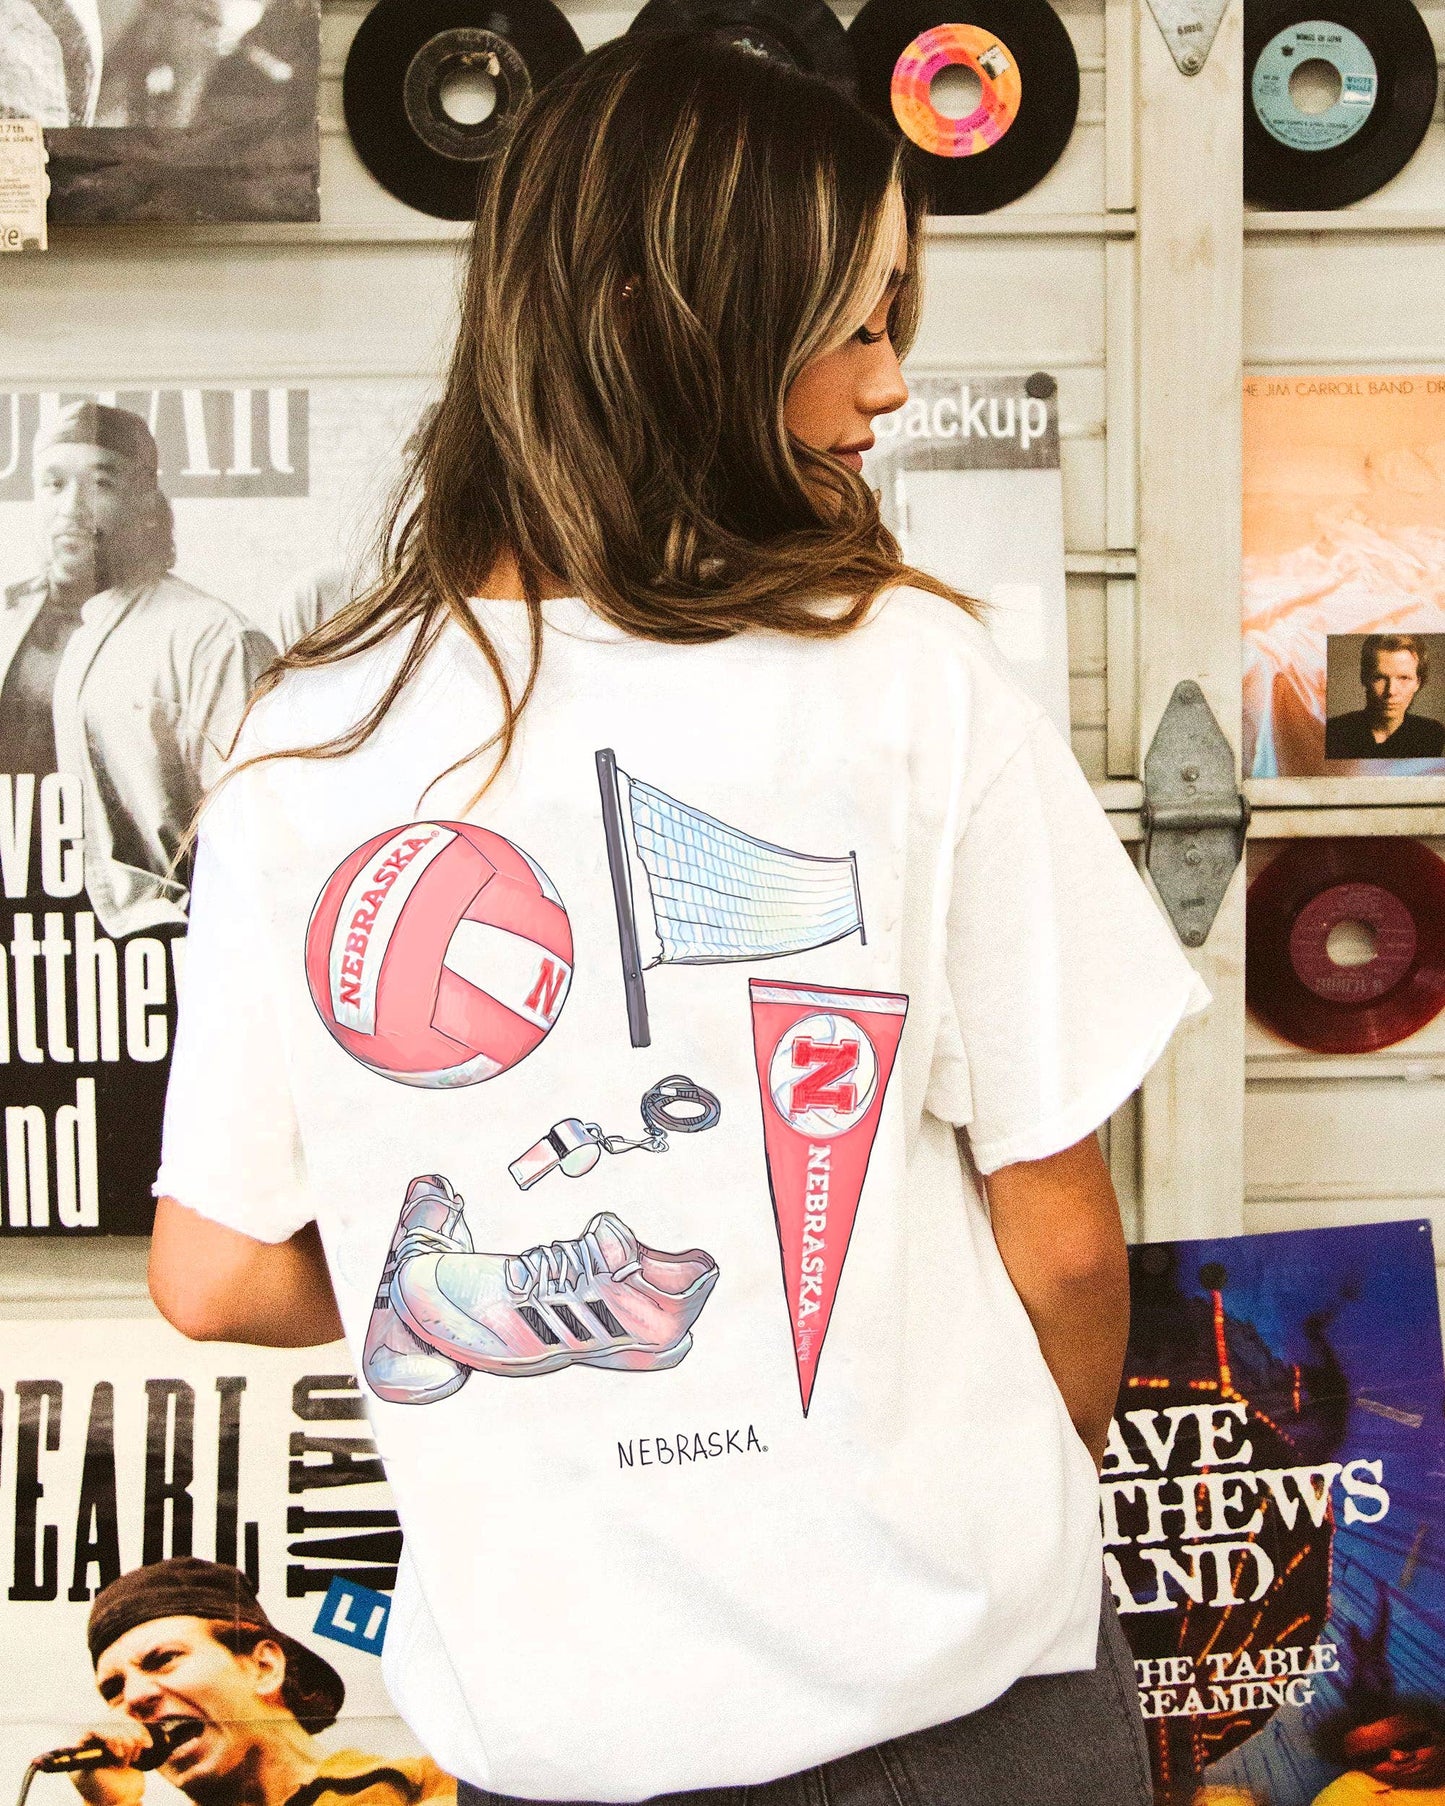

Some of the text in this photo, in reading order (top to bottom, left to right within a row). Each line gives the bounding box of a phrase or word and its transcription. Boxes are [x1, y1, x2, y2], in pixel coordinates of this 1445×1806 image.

[1266, 383, 1290, 396] JIM
[1296, 382, 1363, 396] CARROLL
[1369, 381, 1414, 395] BAND
[0, 912, 186, 1064] tthe
[790, 1036, 860, 1114] N
[0, 1077, 99, 1228] nd
[0, 1376, 260, 1602] EARL
[1206, 1643, 1341, 1683] TABLE
